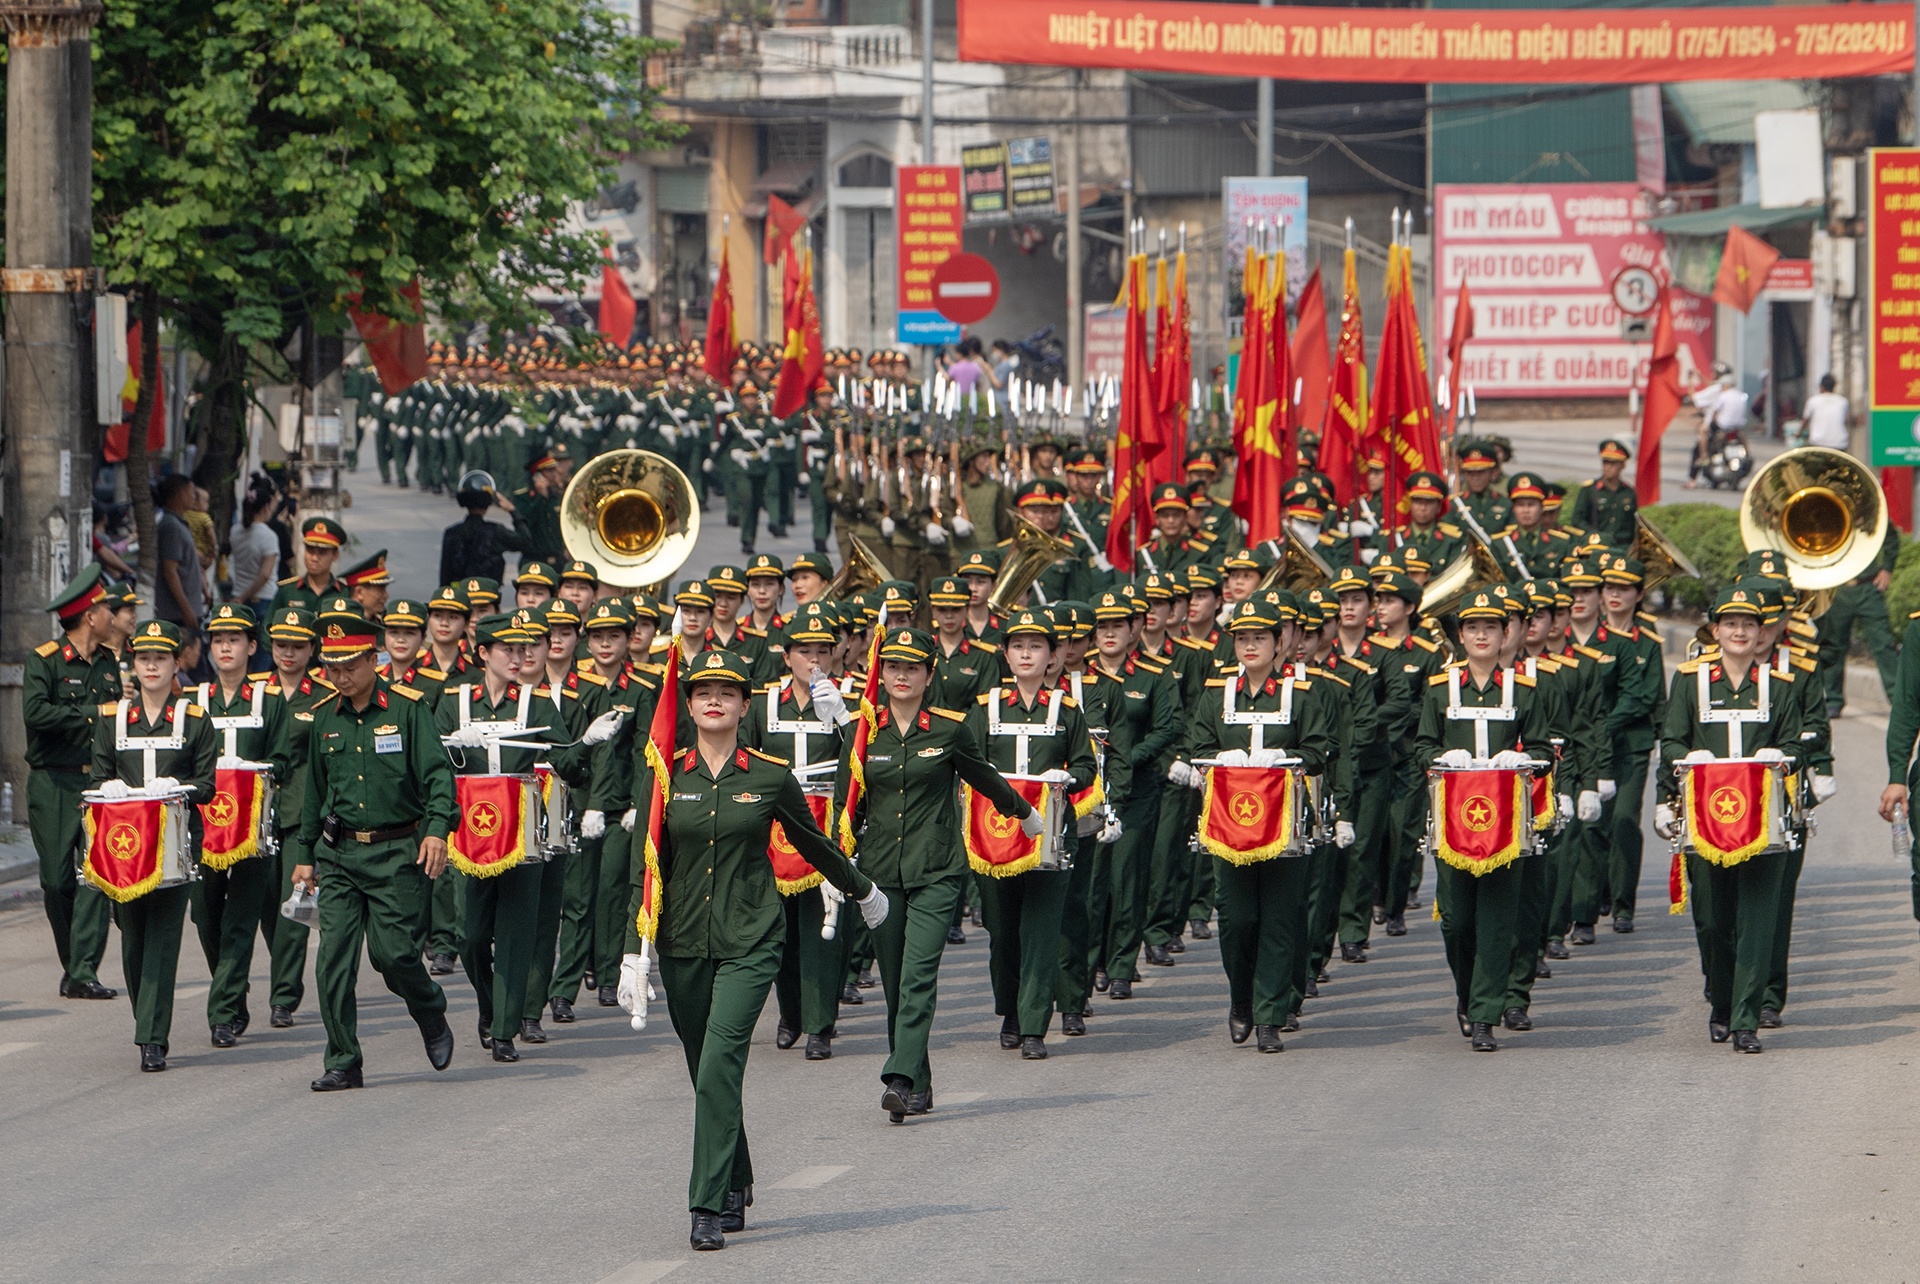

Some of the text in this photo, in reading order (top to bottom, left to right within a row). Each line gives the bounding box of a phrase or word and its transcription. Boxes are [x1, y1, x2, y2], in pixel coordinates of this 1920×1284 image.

[1049, 11, 1110, 50] NHIỆT
[1114, 13, 1157, 54] LIỆT
[1162, 16, 1218, 53] CHÀO
[1221, 18, 1286, 55] MỪNG
[1290, 25, 1317, 57] 70
[1321, 21, 1371, 58] NĂM
[1375, 21, 1438, 60] CHIẾN
[1443, 22, 1513, 61] THẮNG
[1516, 22, 1569, 65] ĐIỆN
[1572, 23, 1623, 60] BIÊN
[1628, 20, 1671, 58] PHỦ
[1677, 25, 1777, 61] (7/5/1954
[1452, 202, 1546, 229] IN MÀU
[1452, 254, 1586, 277] PHOTOCOPY
[1488, 301, 1557, 331] THIỆP
[1462, 351, 1509, 380] HIẾT
[1519, 351, 1544, 380] KẾ
[1554, 351, 1630, 382] QUẢNG
